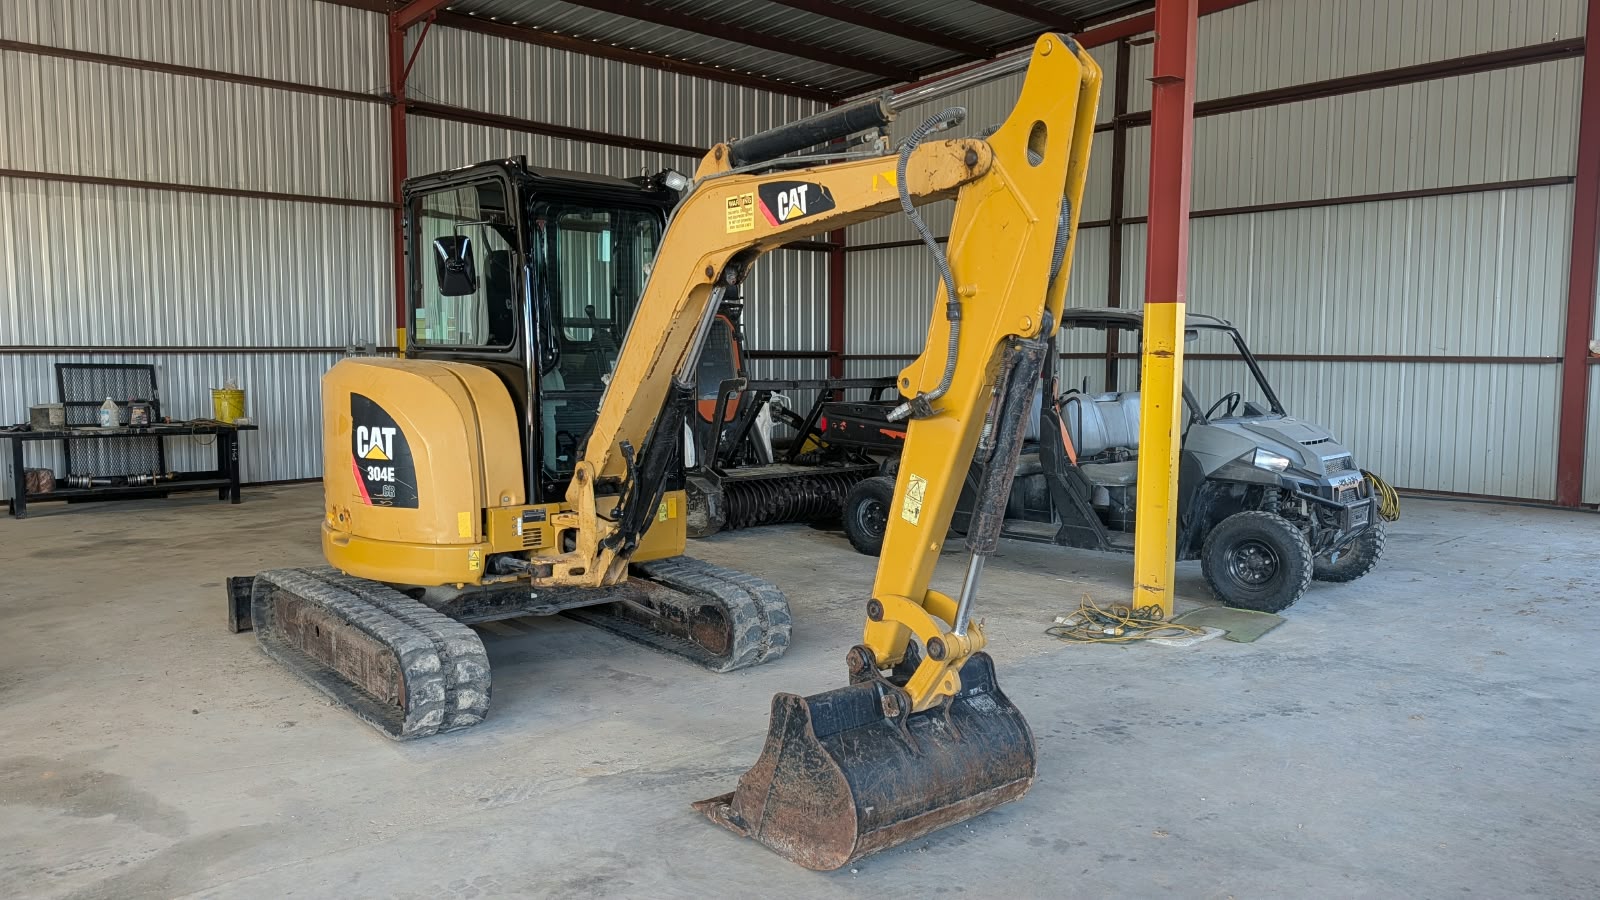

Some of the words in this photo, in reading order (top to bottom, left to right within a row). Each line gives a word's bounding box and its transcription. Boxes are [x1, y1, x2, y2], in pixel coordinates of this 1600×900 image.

[728, 196, 752, 207] WARING
[777, 184, 808, 221] CAT
[356, 425, 396, 460] CAT
[367, 465, 395, 482] 304E
[382, 484, 396, 497] CR
